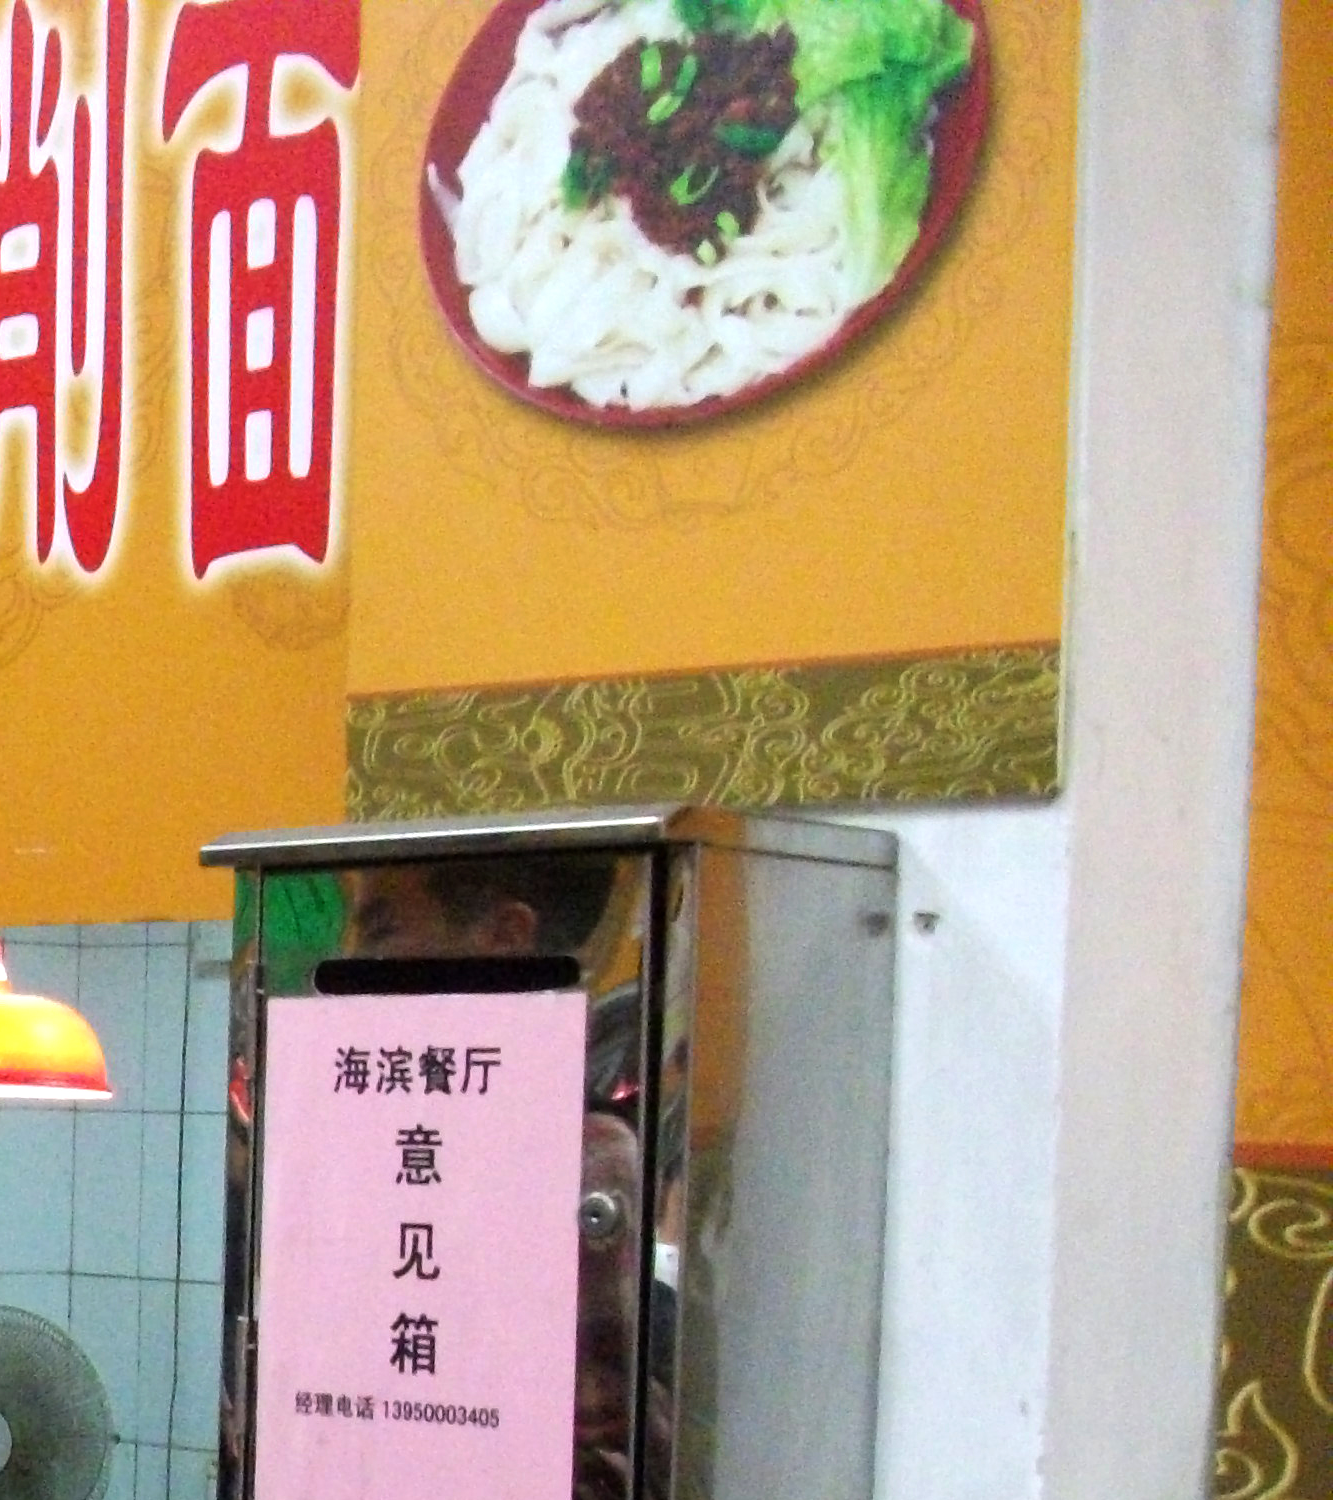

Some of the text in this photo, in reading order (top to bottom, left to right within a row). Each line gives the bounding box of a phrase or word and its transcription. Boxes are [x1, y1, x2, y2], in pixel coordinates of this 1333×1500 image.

[333, 1045, 503, 1096] 海滨餐厅
[388, 1123, 444, 1376] 意见箱
[294, 1389, 501, 1429] 经理电话 13950003405
